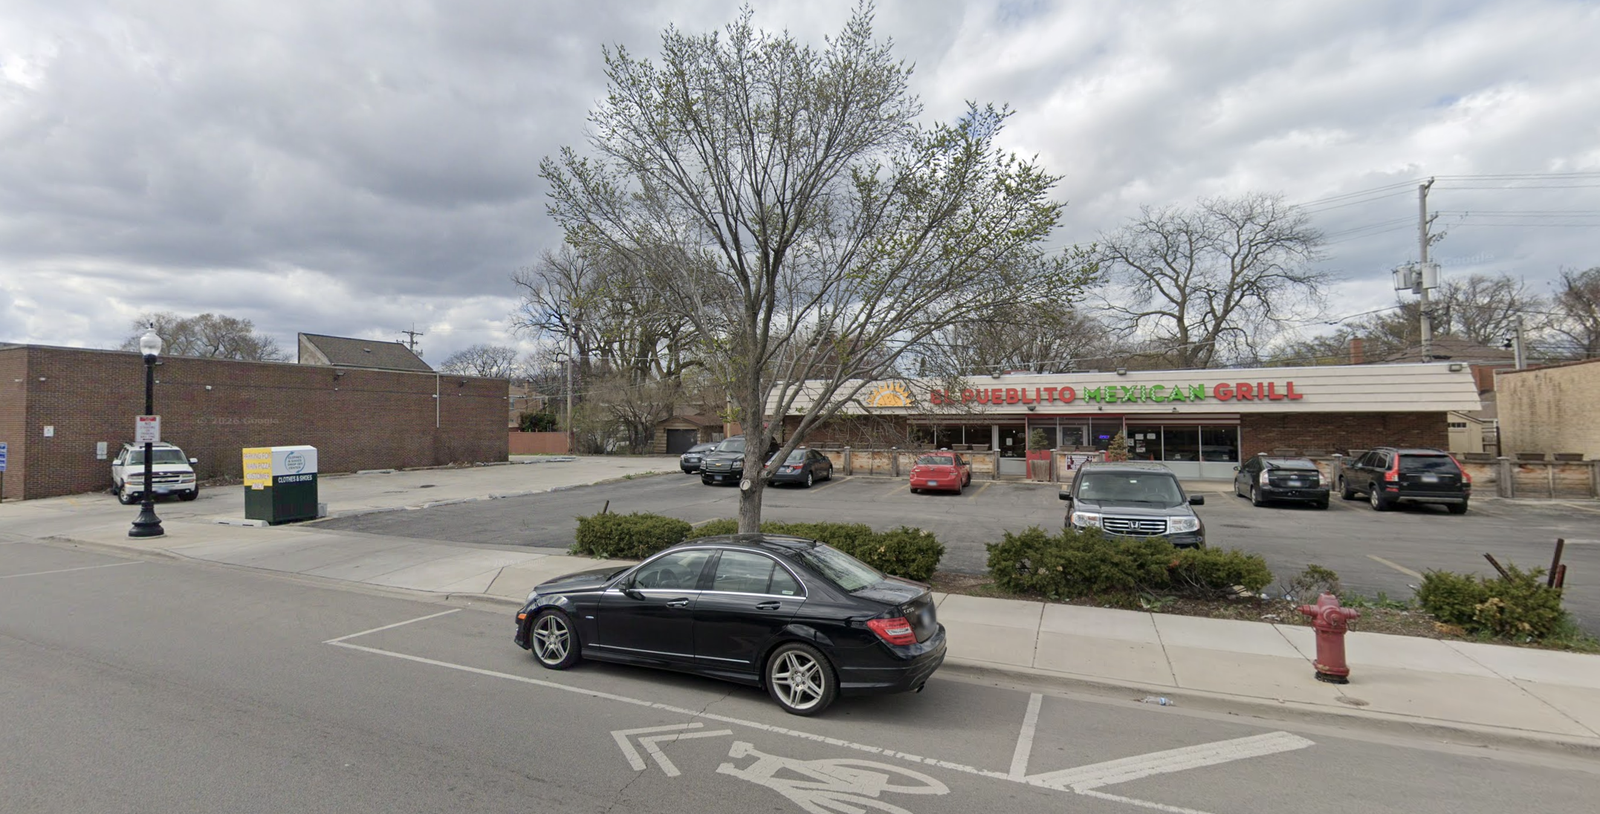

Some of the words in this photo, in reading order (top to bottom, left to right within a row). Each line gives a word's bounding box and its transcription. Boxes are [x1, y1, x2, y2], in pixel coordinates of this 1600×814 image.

[930, 389, 955, 404] EL
[961, 386, 1077, 404] PUEBLITO
[1083, 383, 1206, 404] MEXICAN
[1213, 381, 1304, 401] GRILL
